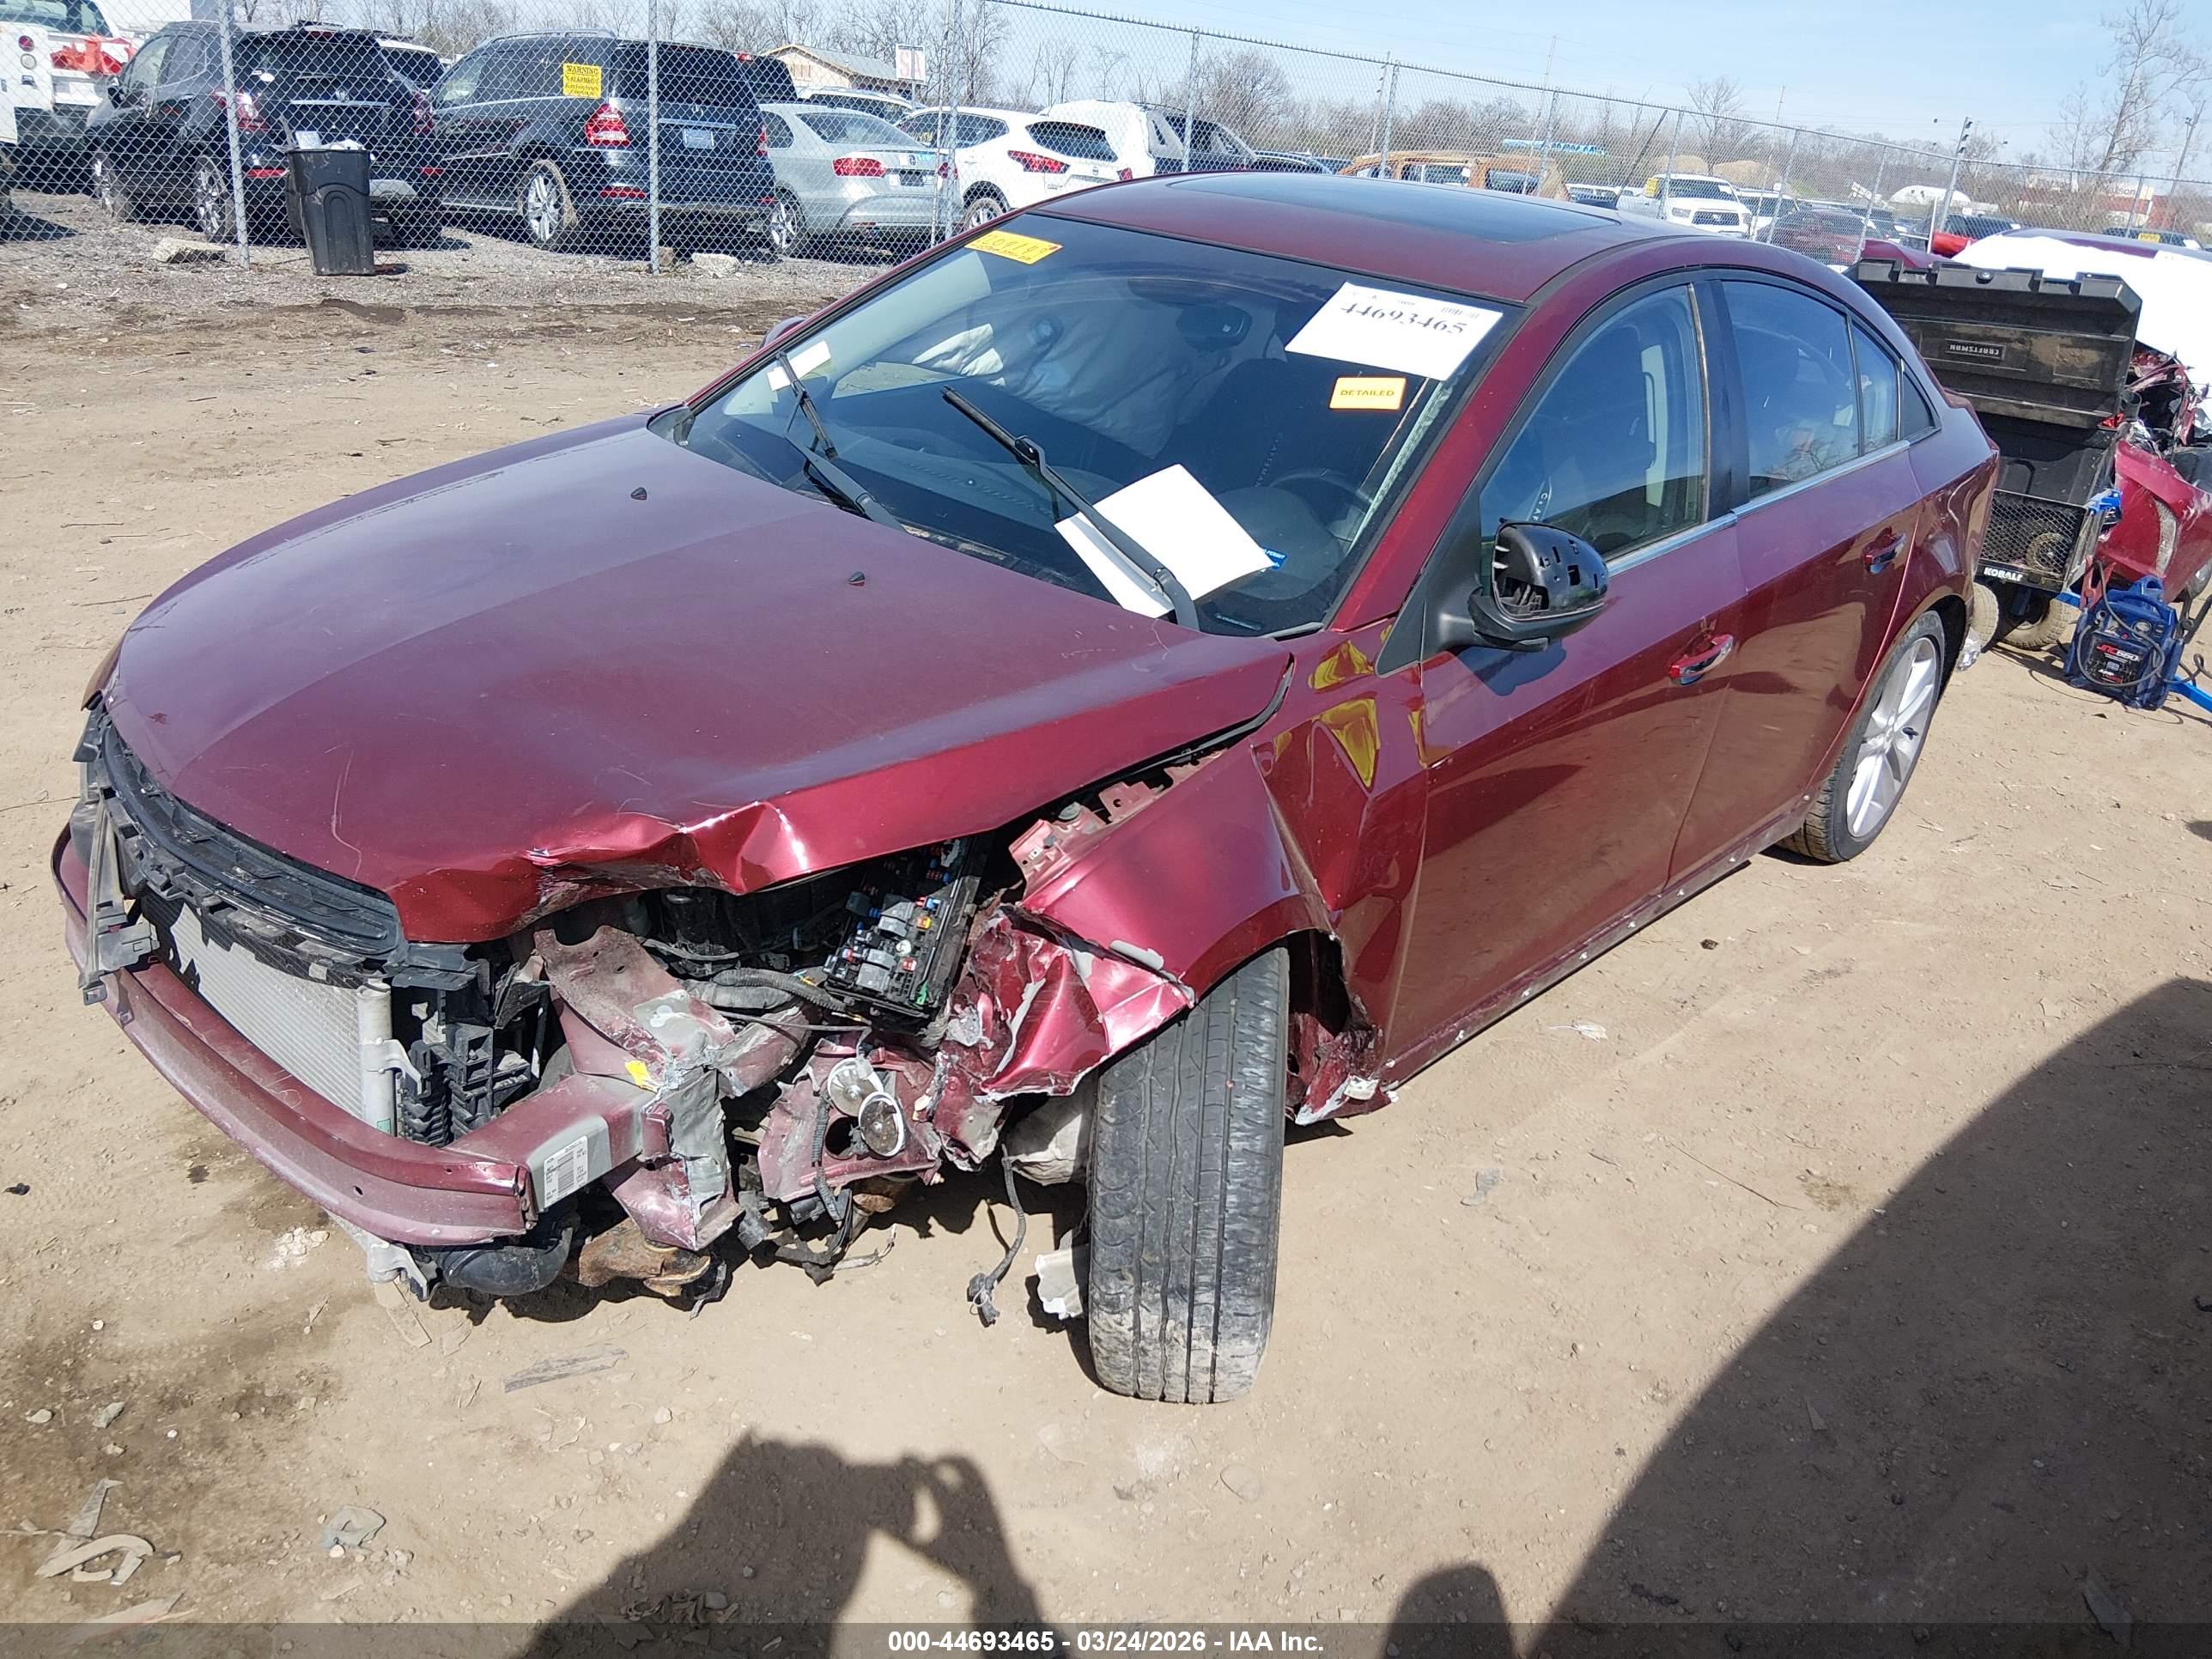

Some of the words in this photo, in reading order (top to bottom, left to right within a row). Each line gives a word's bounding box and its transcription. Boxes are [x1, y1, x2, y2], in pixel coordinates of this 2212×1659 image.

[566, 65, 599, 76] WARNING
[1341, 302, 1468, 334] 44693465
[1949, 343, 2000, 356] CRAFTSMAN
[1984, 567, 2023, 582] KOBALT
